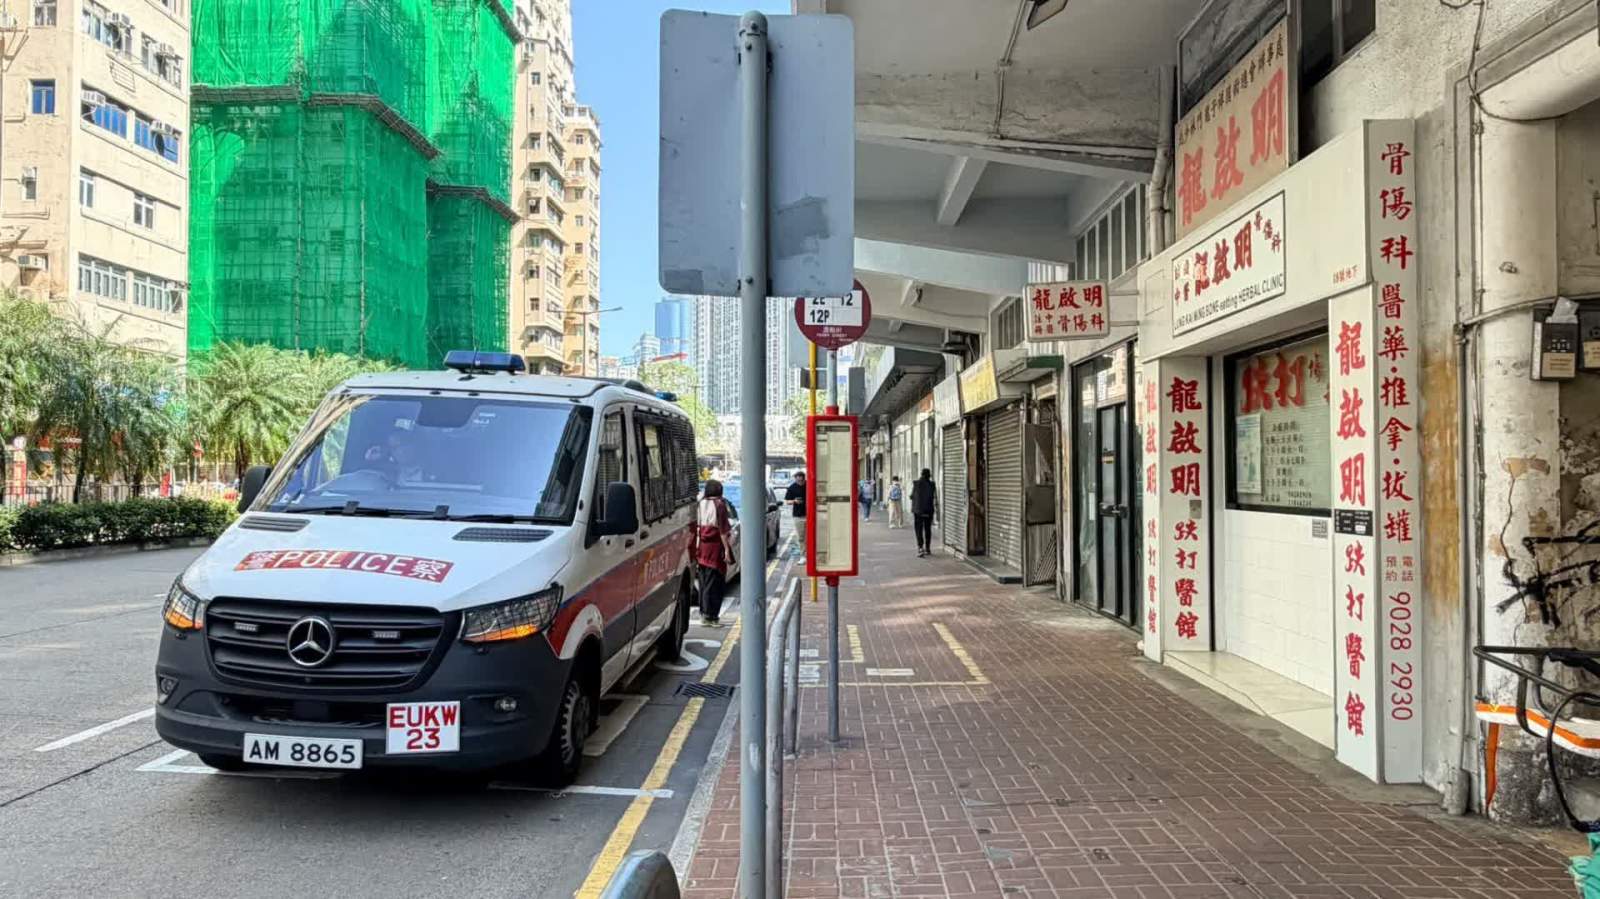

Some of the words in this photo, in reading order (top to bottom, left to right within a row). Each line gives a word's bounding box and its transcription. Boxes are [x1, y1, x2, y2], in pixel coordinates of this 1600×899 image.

[1193, 220, 1253, 297] 龍啟明
[1032, 285, 1104, 311] 龍啟明
[1261, 273, 1284, 295] CLINIC
[809, 309, 830, 323] 12P
[1336, 320, 1369, 507] 龍啟明
[1167, 376, 1202, 497] 龍啟明
[274, 549, 413, 577] POLICE
[1174, 519, 1200, 640] 跌打醫館
[1343, 542, 1366, 737] 跌打醫館
[1390, 591, 1413, 651] 9028
[1390, 661, 1414, 721] 2930
[389, 705, 458, 729] EUKW
[406, 727, 440, 749] 23
[248, 739, 280, 761] AM
[290, 742, 356, 765] 8865
